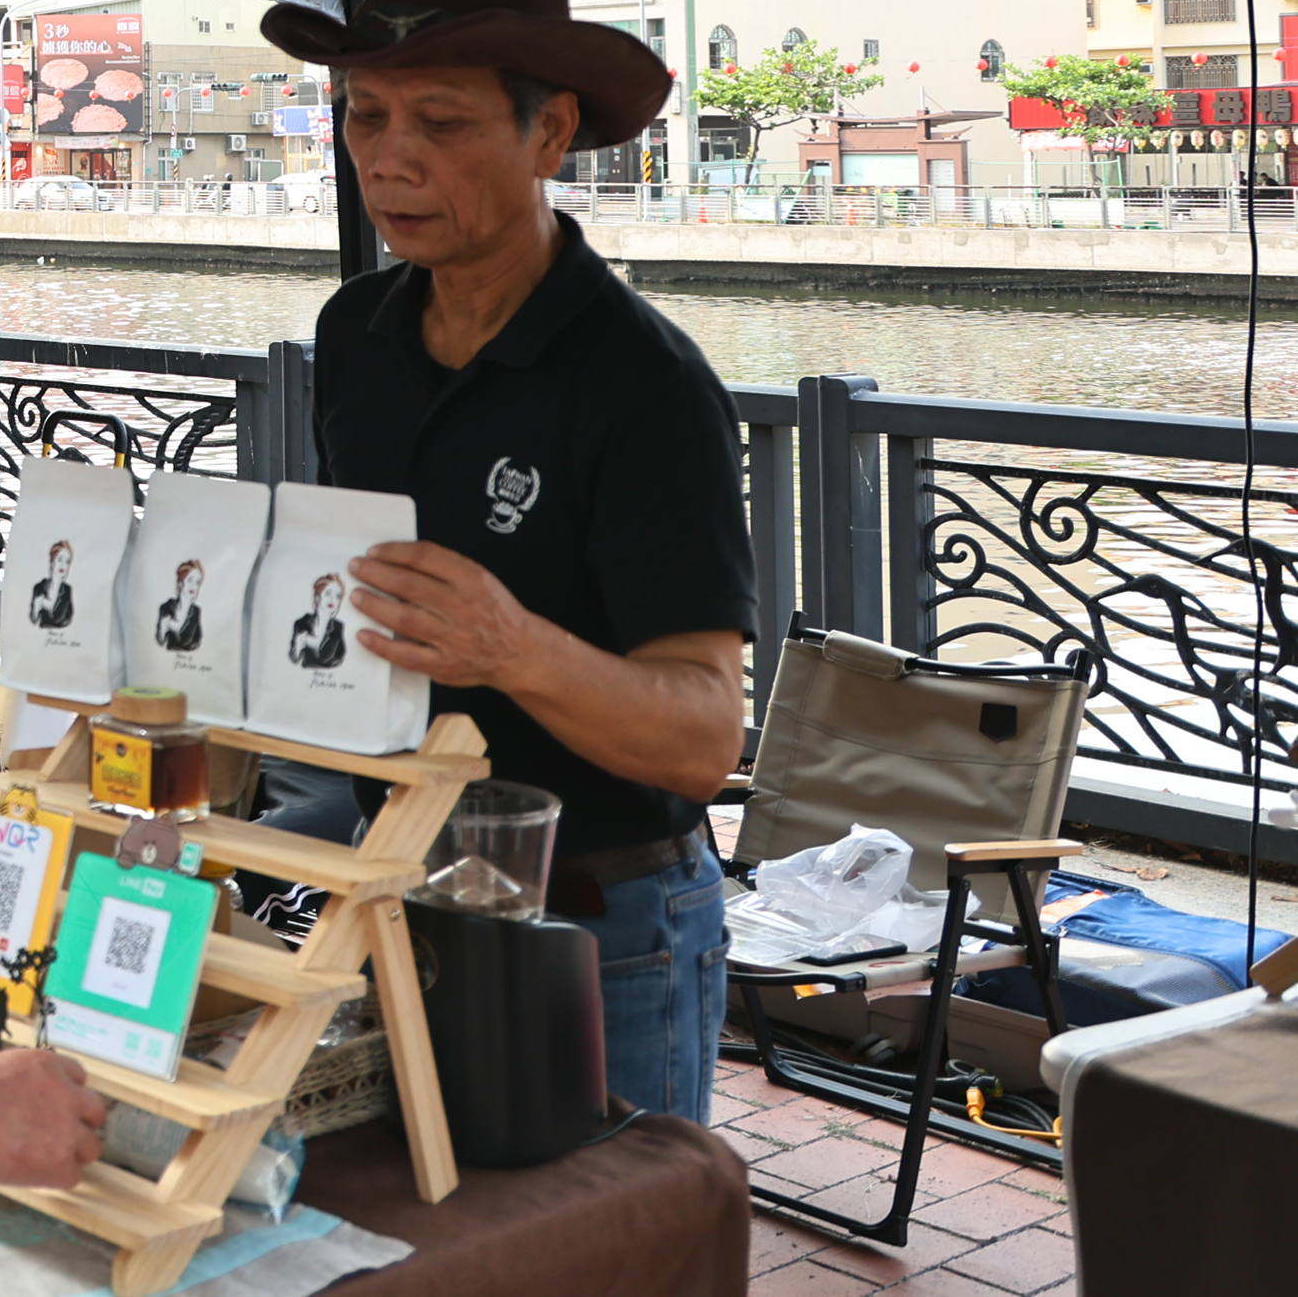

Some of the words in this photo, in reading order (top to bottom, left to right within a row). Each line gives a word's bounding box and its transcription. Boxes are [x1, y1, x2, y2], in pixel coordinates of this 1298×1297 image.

[43, 23, 70, 39] 3秒
[42, 39, 113, 54] 擄獲你的心
[502, 466, 532, 485] TAIWAN
